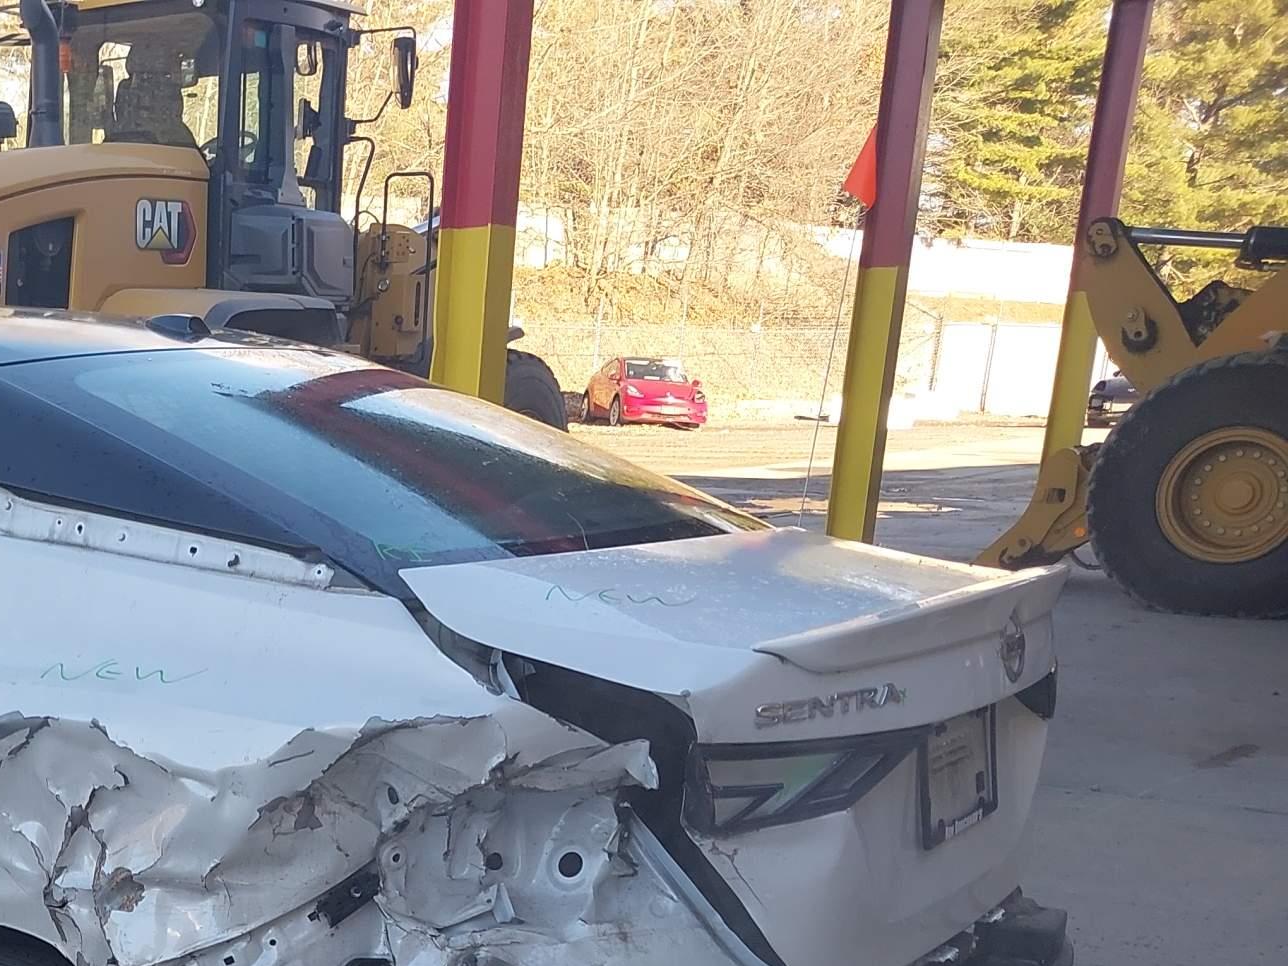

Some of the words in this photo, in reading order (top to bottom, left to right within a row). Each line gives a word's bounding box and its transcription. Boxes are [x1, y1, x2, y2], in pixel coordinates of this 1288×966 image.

[137, 199, 182, 249] CAT
[545, 584, 698, 607] NEW
[40, 657, 210, 684] NEW
[754, 682, 901, 726] SENTRA
